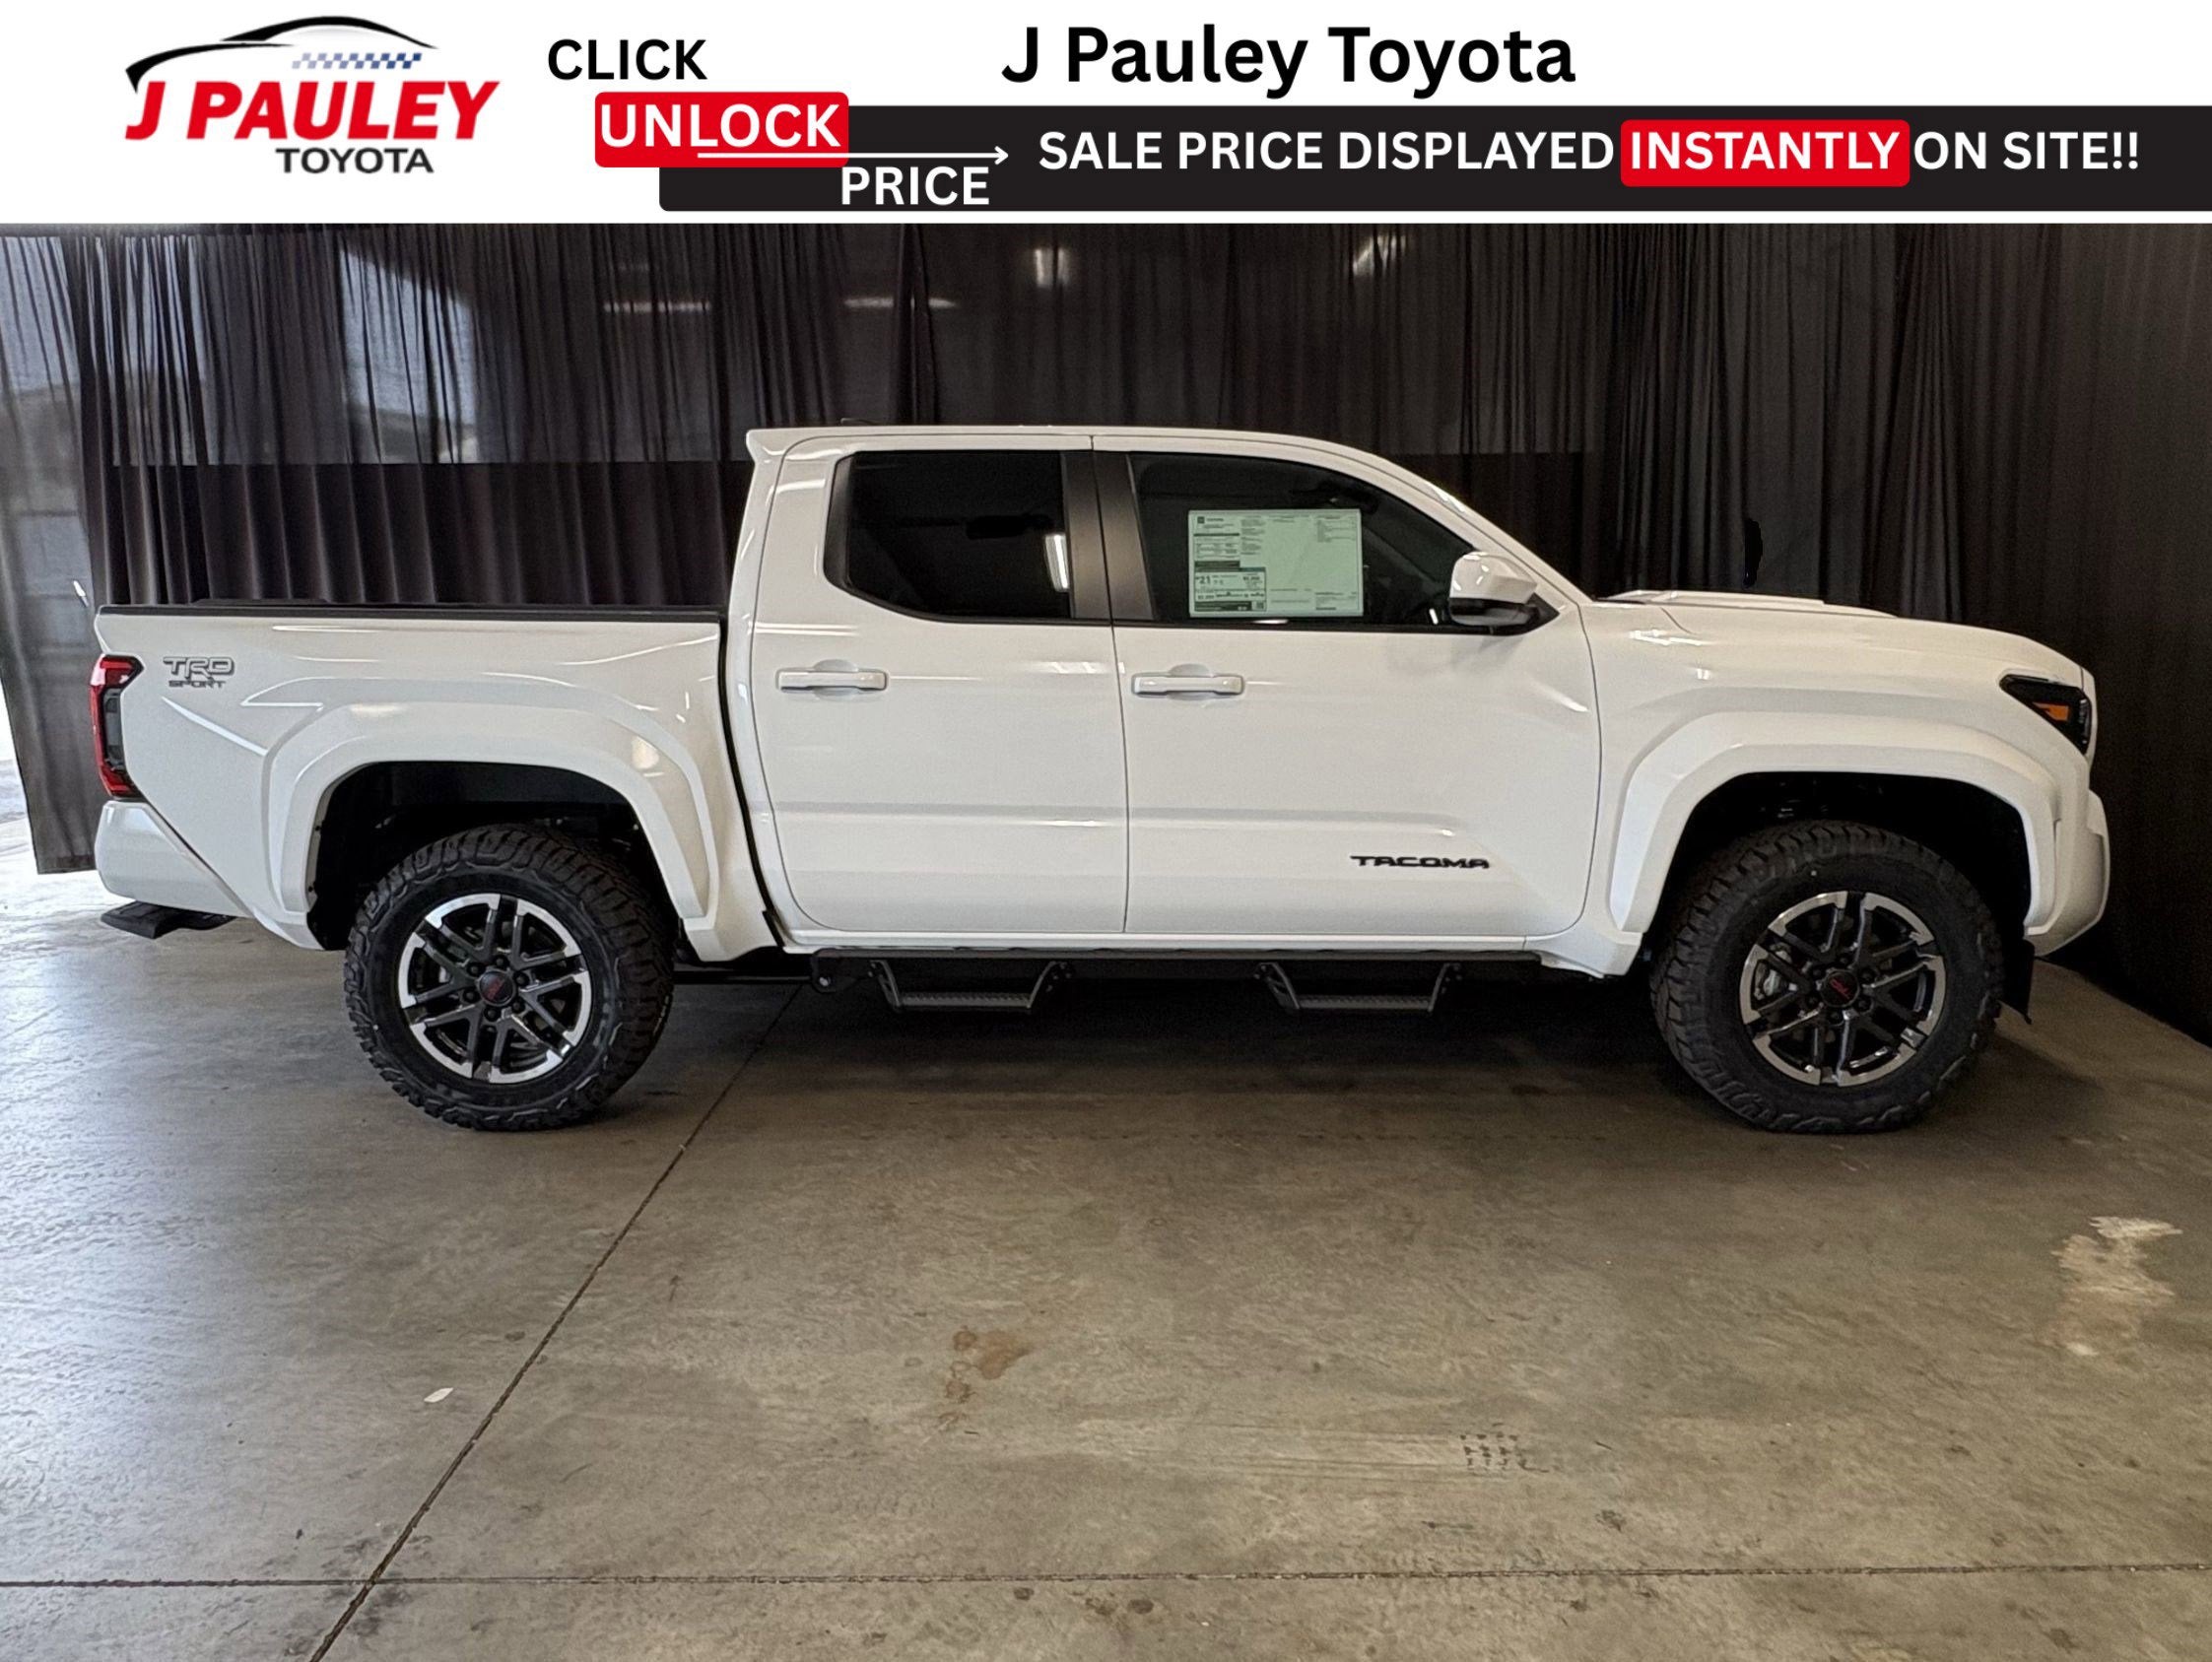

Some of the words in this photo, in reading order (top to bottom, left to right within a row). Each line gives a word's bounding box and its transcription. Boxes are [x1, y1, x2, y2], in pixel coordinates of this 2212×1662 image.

[163, 656, 235, 681] TRD
[168, 679, 227, 689] SPORT
[1349, 855, 1490, 869] TACOMA
